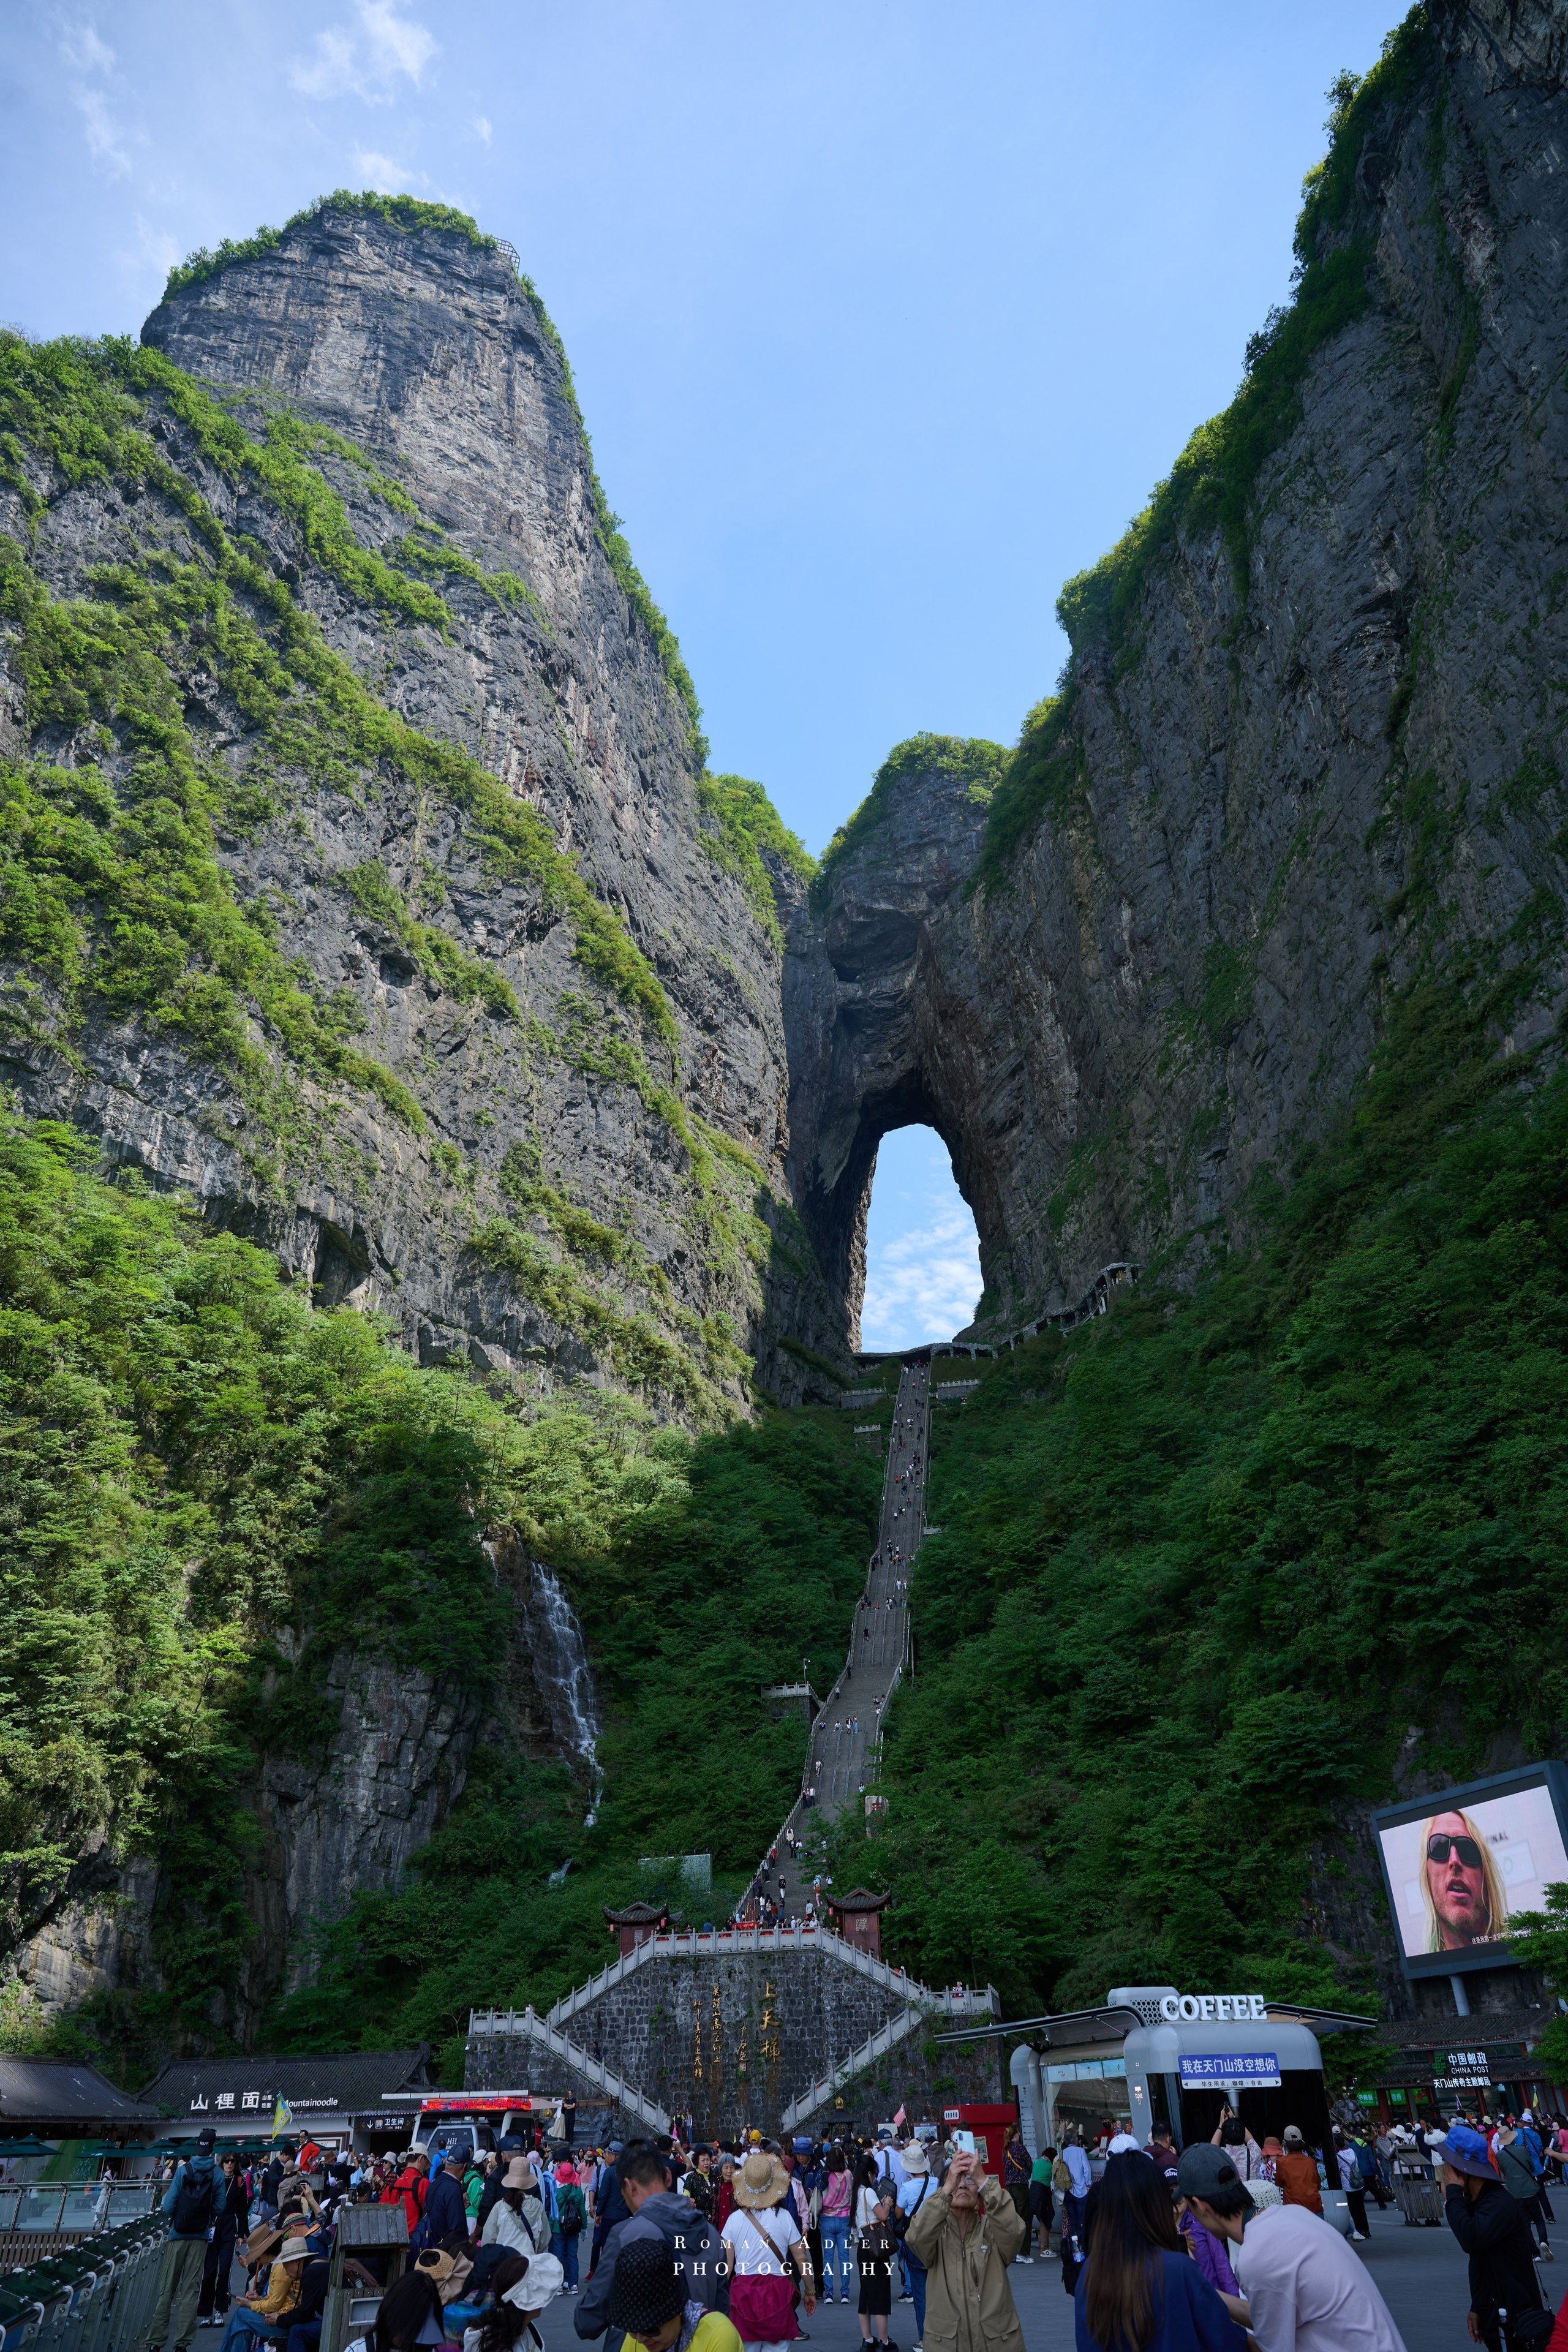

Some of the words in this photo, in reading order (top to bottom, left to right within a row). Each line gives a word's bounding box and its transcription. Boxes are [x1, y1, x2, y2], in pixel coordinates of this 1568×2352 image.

[1159, 1995, 1267, 2021] COFFEE
[759, 1981, 782, 2063] 上天梯
[1182, 2058, 1276, 2073] 我在天门山没空想你
[1448, 2051, 1488, 2066] 中国邮政
[1433, 2077, 1491, 2088] 天门山传奇主题邮局
[191, 2092, 260, 2110] 山裡面
